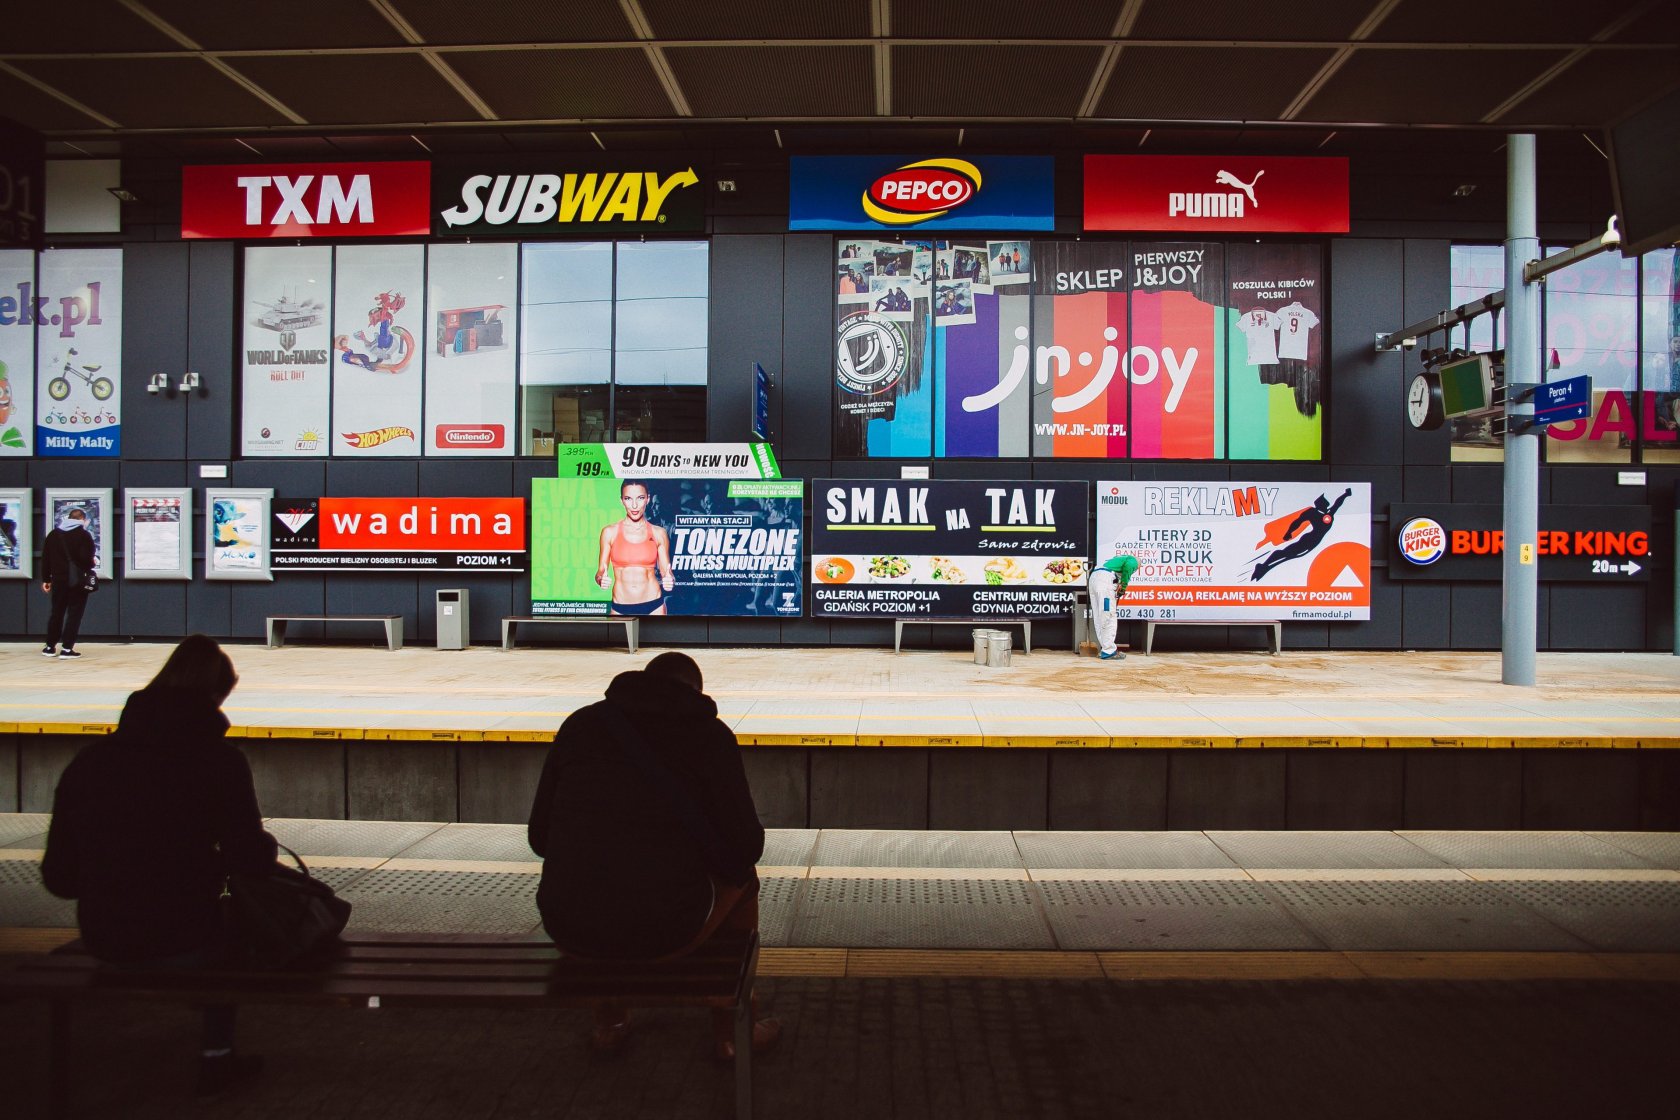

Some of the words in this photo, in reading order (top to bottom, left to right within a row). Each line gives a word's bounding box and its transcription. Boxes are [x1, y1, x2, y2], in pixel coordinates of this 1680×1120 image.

[440, 166, 700, 228] SUBWAY
[880, 180, 965, 201] PEPCO
[237, 174, 374, 225] TXM
[1169, 193, 1244, 218] PUMA
[1134, 250, 1204, 266] PIERWSZY
[1056, 269, 1123, 291] SKLEP
[1133, 265, 1202, 287] J&JOY
[1232, 281, 1276, 289] KOSZULKA
[1278, 278, 1315, 288] KIBICÓW
[1257, 291, 1286, 299] POLSKI
[1290, 318, 1298, 333] 9
[247, 350, 286, 366] WORLD
[292, 349, 328, 365] TANKS
[1548, 387, 1567, 398] Peron
[1567, 382, 1572, 394] 4
[449, 432, 491, 441] Nintendo
[1034, 423, 1127, 437] WWW.JN-JOY.PL
[45, 436, 77, 450] Milly
[80, 436, 114, 450] Mally
[566, 447, 585, 456] 399
[621, 446, 650, 467] 90
[650, 454, 682, 467] DAYS
[693, 454, 722, 467] NEW
[725, 454, 749, 467] YOU
[576, 461, 601, 476] 199
[826, 487, 929, 524] SMAK
[945, 508, 971, 531] NA
[985, 488, 1056, 525] TAK
[1144, 486, 1279, 518] REKLAMY
[332, 506, 511, 535] wadima
[679, 517, 709, 525] WITAMY
[710, 517, 722, 525] NA
[723, 517, 749, 525] STACJI
[674, 528, 799, 555] TONEZONE
[1138, 529, 1188, 542] LITERY
[1192, 529, 1212, 542] 3D
[1404, 527, 1440, 542] BURGER
[978, 539, 1019, 549] Samo
[1022, 539, 1077, 551] zdrowie
[1115, 541, 1155, 549] GADŻETY
[1405, 535, 1441, 553] KING
[1451, 530, 1569, 555] BURER
[1574, 531, 1649, 556] KING
[275, 556, 299, 564] POLSKI
[300, 556, 340, 564] PRODUCENT
[340, 556, 369, 564] BIELIZNY
[456, 555, 497, 566] POZIOM
[499, 555, 511, 566] +1
[1115, 549, 1157, 558] BANERY
[1161, 550, 1213, 564] DRUK
[672, 555, 725, 571] FITNESS
[725, 555, 796, 571] MULTIPLEX
[1592, 560, 1618, 574] 20m
[816, 590, 866, 600] GALERIA
[867, 590, 940, 601] METROPOLIA
[973, 591, 1029, 601] CENTRUM
[1030, 591, 1074, 602] RIVIERA
[1157, 590, 1194, 603] SWOJĄ
[1196, 591, 1245, 603] REKLAMĘ
[1247, 591, 1262, 601] NA
[1264, 589, 1307, 601] WYŻSZY
[1309, 591, 1352, 601] POZIOM
[823, 600, 871, 612] GDAŃSK
[872, 602, 916, 612] POZIOM
[918, 603, 931, 612] +1
[972, 603, 1017, 613] GDYNIA
[1018, 603, 1060, 614] POZIOM
[1062, 604, 1074, 614] +1
[1137, 608, 1155, 618] 430
[1160, 608, 1176, 618] 281
[1292, 609, 1352, 619] firmamodul.pl
